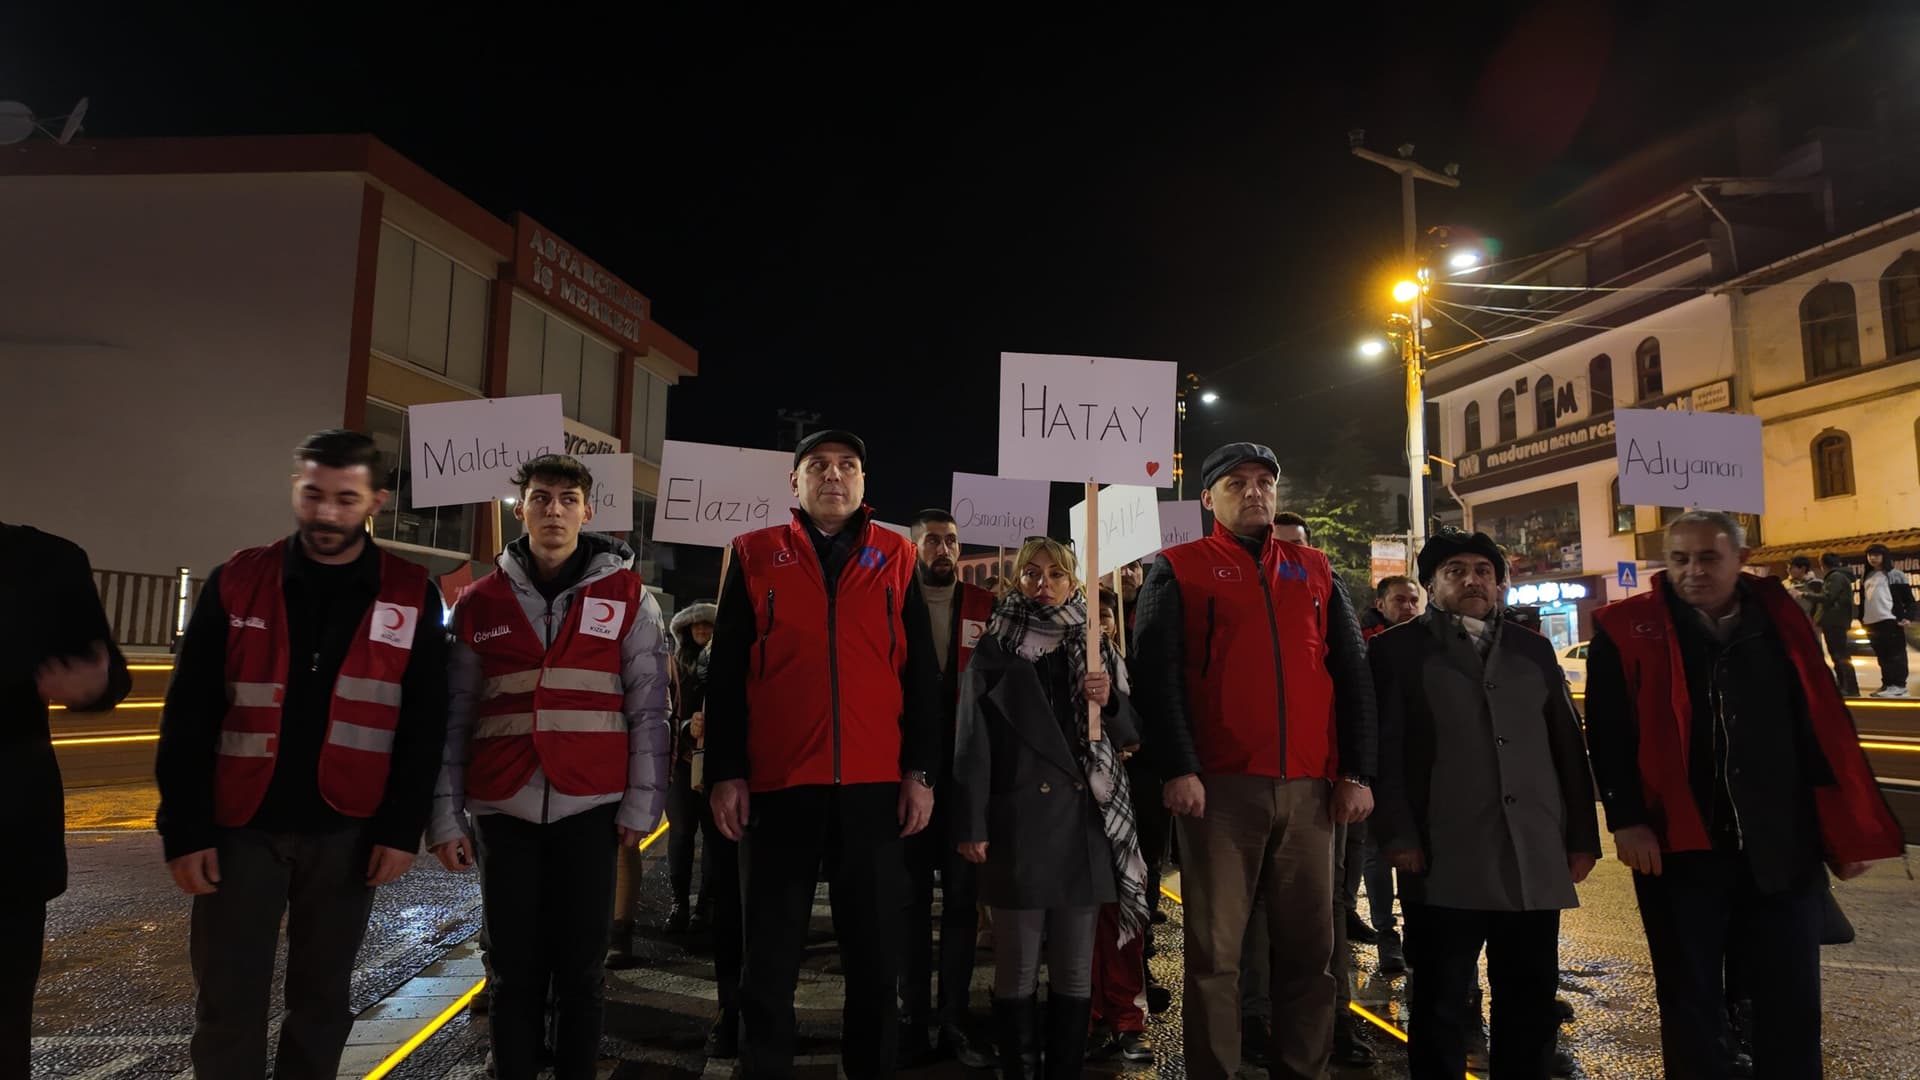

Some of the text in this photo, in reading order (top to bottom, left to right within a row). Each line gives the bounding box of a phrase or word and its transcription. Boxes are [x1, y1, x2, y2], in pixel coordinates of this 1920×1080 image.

[533, 256, 639, 343] İŞ MERKEZİ
[1020, 382, 1149, 443] HATAY
[1487, 439, 1548, 468] mudurnu
[1624, 437, 1743, 490] Adıyaman
[664, 477, 770, 528] Elazığ
[954, 497, 1036, 543] Osmaniye
